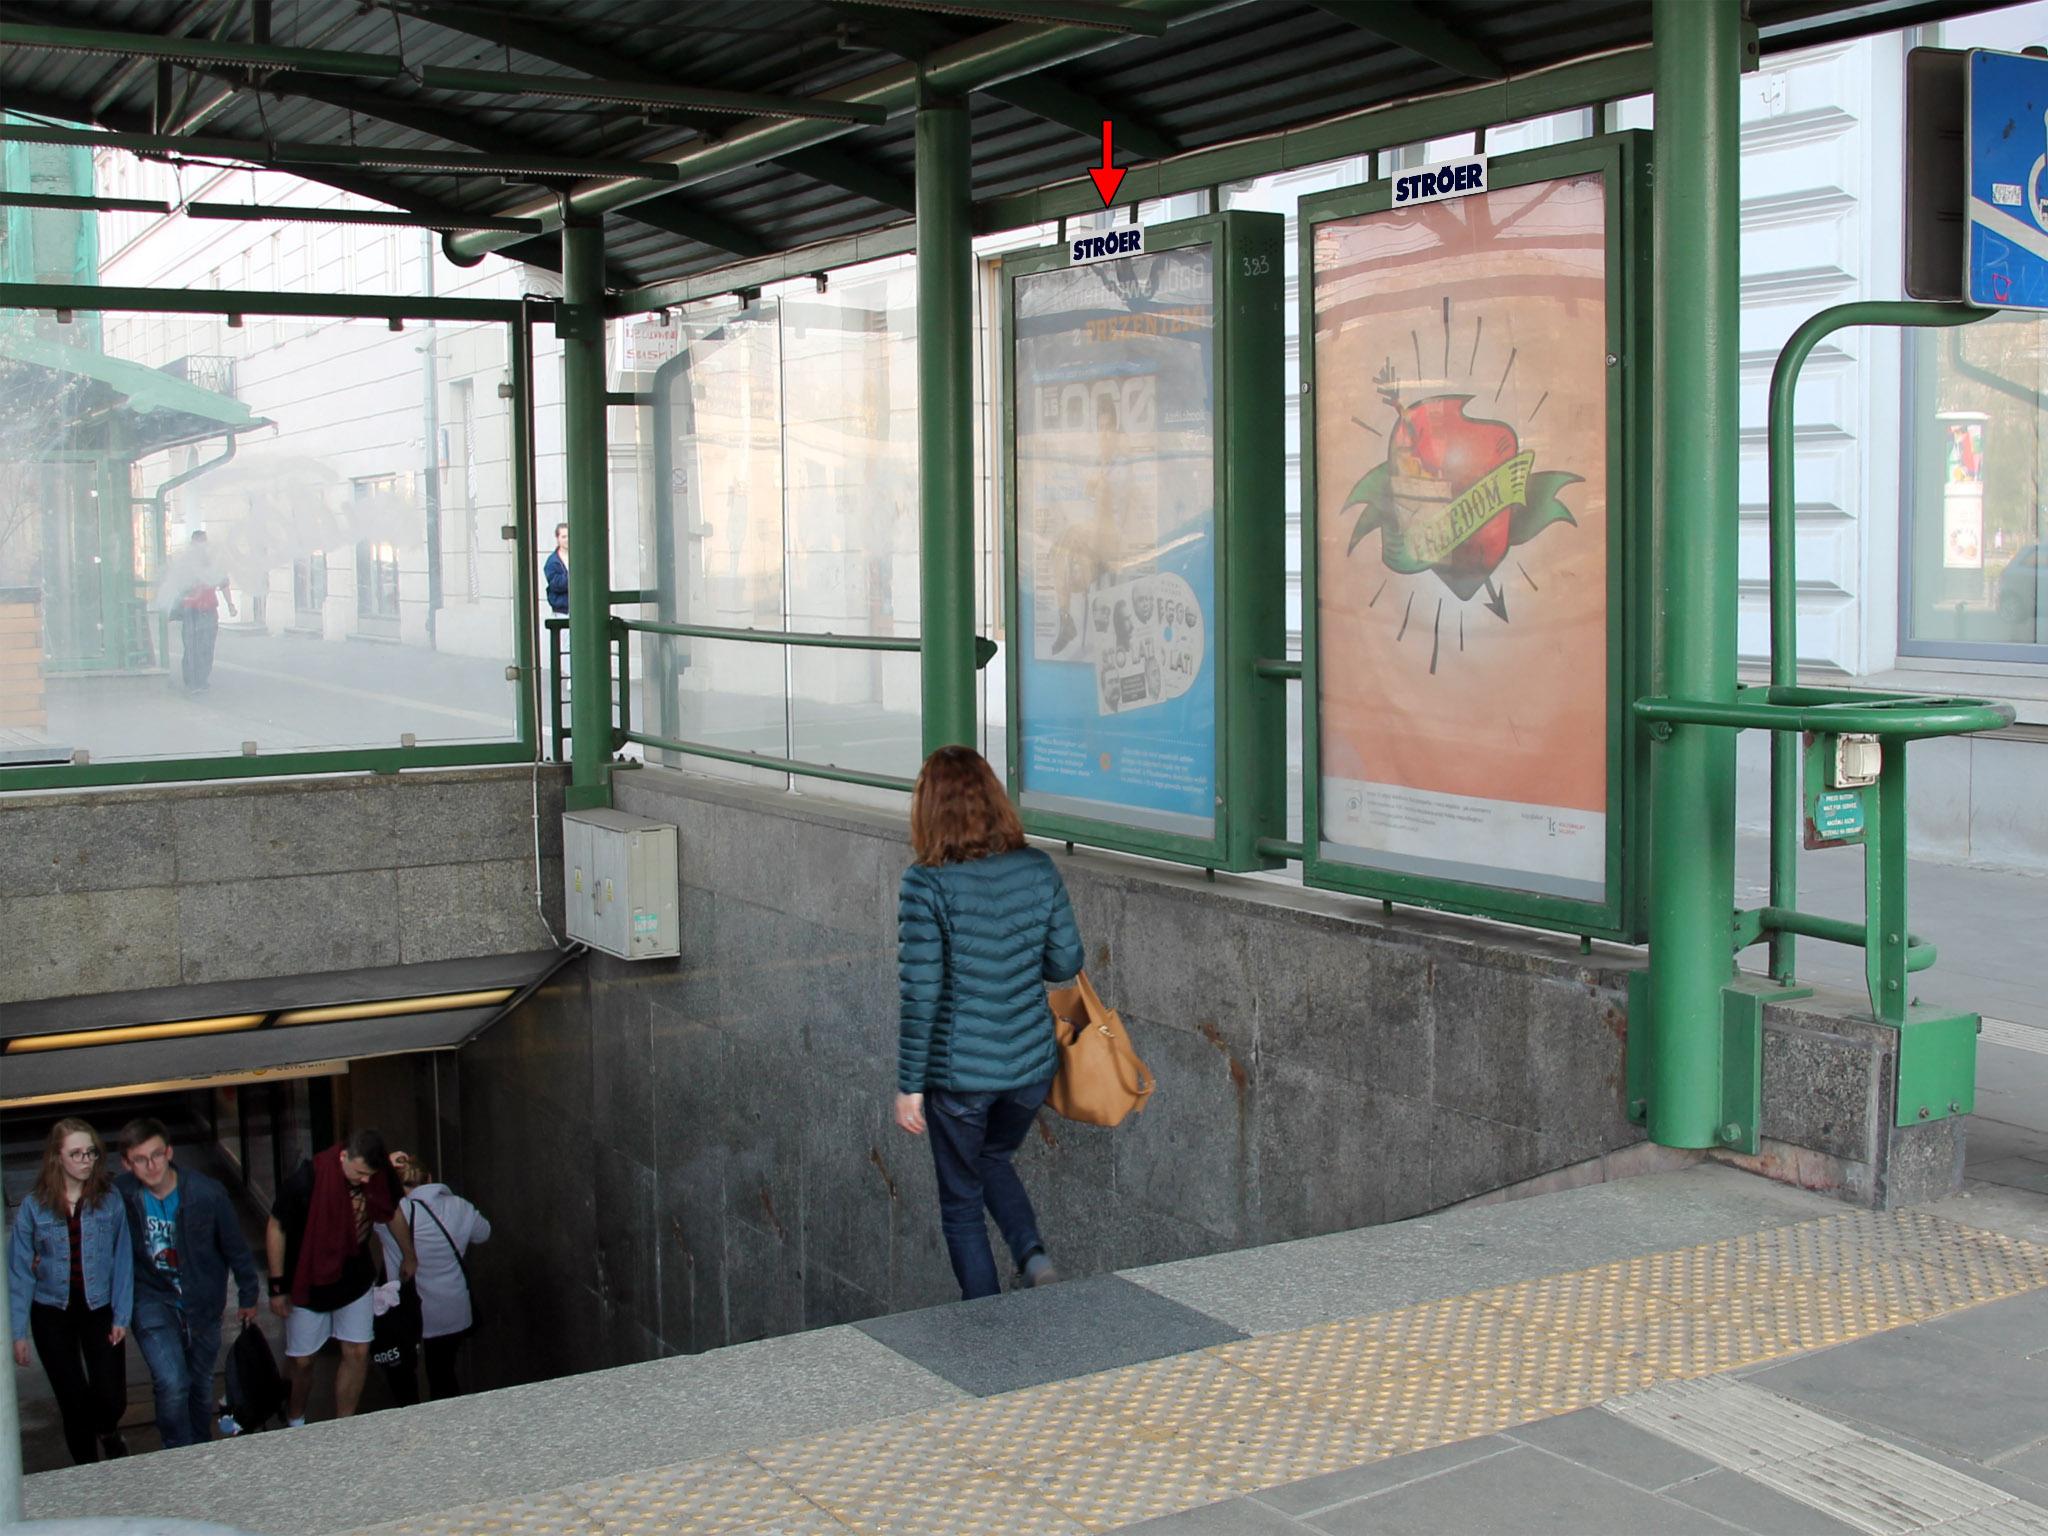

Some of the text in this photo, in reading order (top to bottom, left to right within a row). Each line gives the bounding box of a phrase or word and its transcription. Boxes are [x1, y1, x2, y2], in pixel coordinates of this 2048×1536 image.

[1396, 163, 1483, 201] STRÖER
[1073, 230, 1141, 261] STRÖER
[1243, 255, 1269, 276] 383
